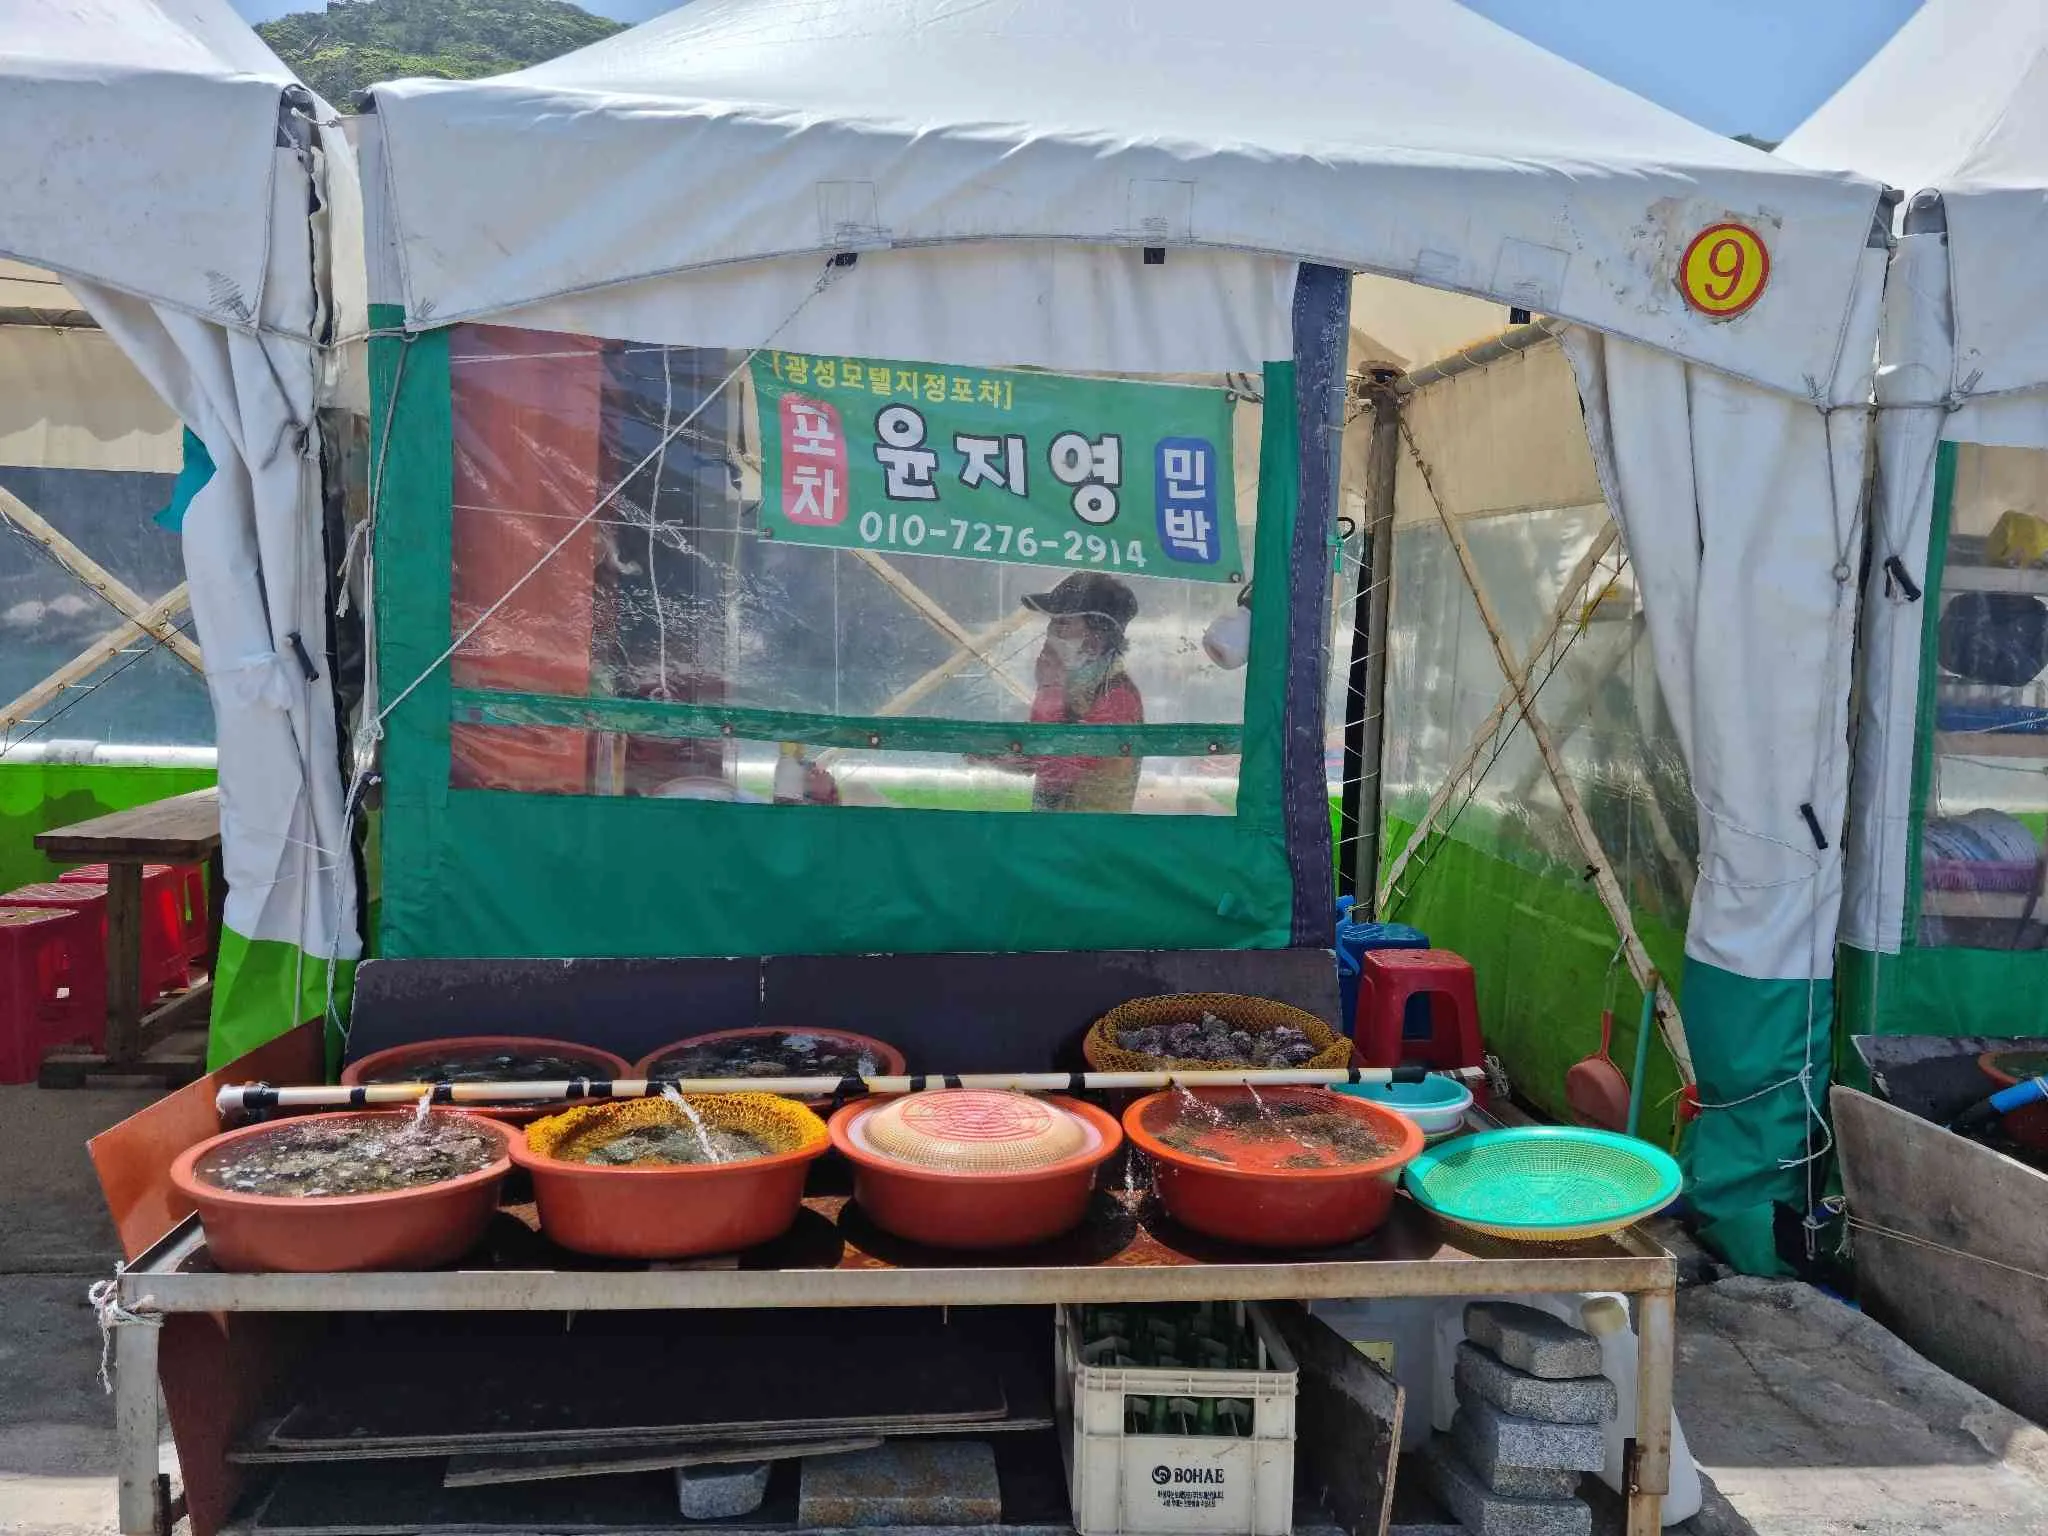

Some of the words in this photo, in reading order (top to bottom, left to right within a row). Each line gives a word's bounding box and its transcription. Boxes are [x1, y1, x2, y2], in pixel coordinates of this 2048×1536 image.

[1705, 239, 1744, 300] 9
[1164, 448, 1212, 560] 민박
[860, 511, 1147, 567] 010-7276-2914
[1174, 1468, 1225, 1484] BOHAE
